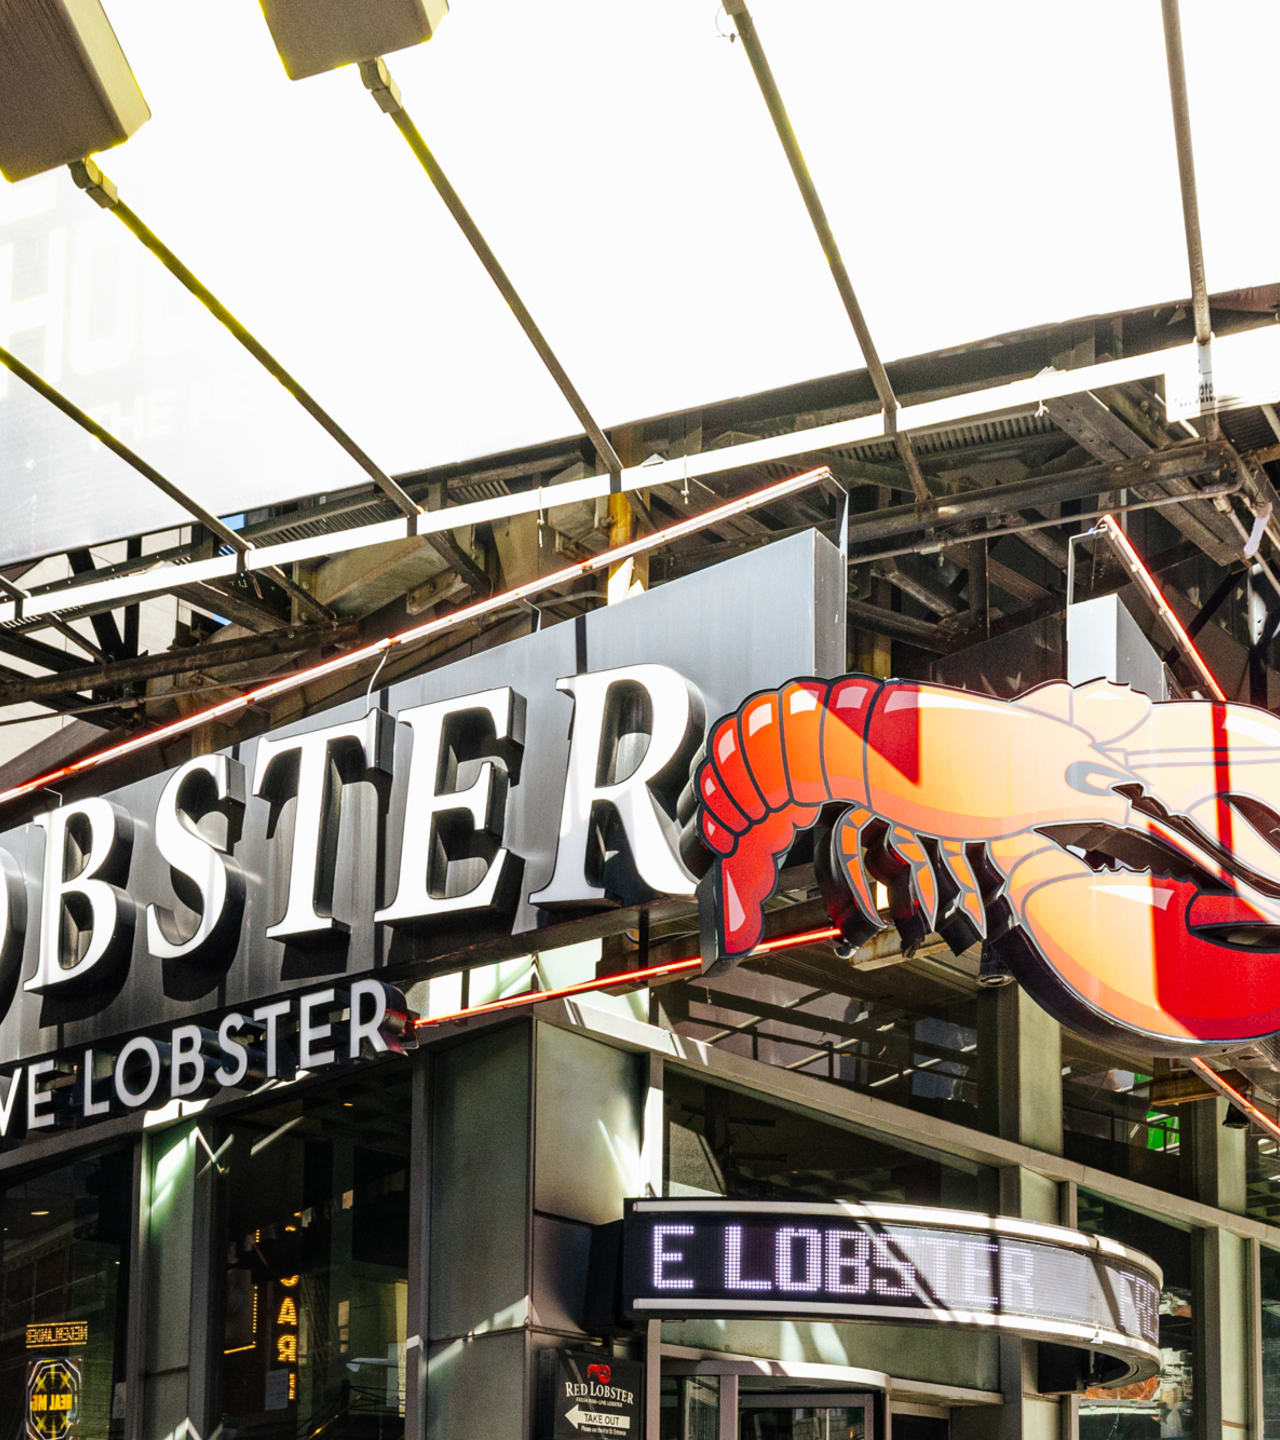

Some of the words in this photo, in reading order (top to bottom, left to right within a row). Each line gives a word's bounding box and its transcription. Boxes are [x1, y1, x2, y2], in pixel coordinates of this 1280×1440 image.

[82, 980, 391, 1118] LOBSTER
[653, 1225, 694, 1289] E
[724, 1226, 1035, 1310] LOBSTER
[565, 1381, 588, 1397] RED
[590, 1381, 634, 1405] LOBSTER
[584, 1413, 602, 1425] TAKE
[604, 1415, 620, 1426] OUT
